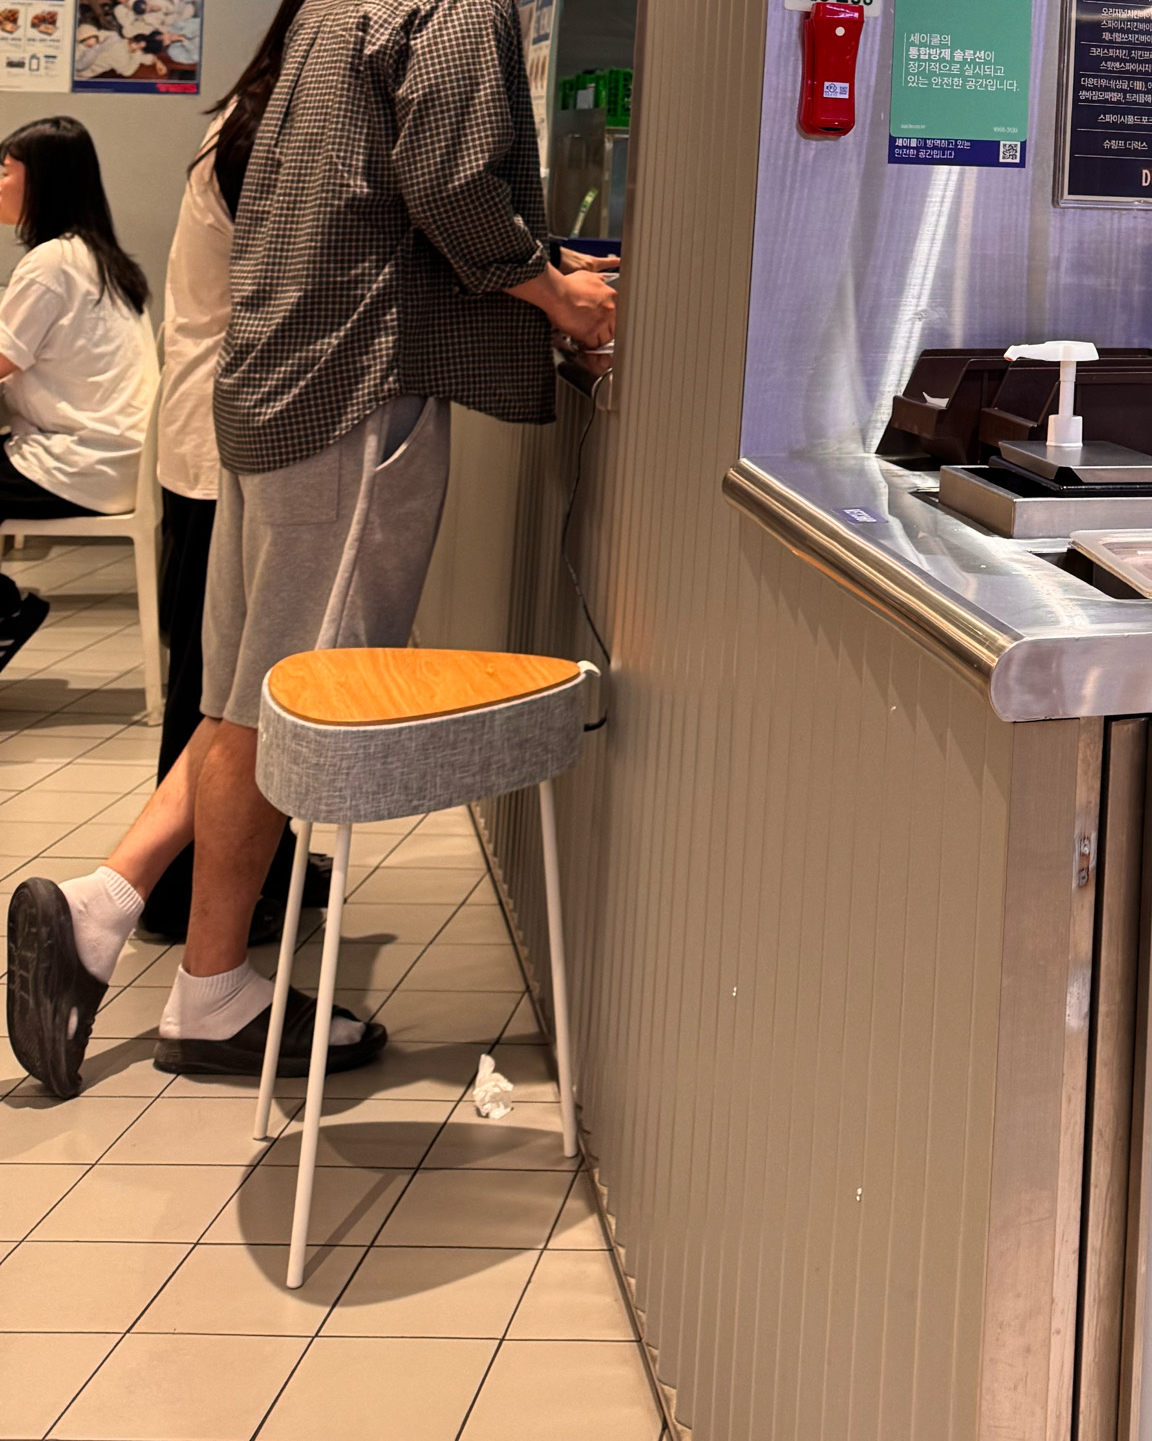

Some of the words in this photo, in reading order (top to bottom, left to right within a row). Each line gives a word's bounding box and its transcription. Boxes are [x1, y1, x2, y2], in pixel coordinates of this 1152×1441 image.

[909, 32, 951, 46] 세이클의
[908, 46, 951, 61] 통합방제
[953, 49, 995, 63] 솔루션이
[908, 61, 960, 74] 정기적으로
[964, 63, 1004, 77] 실시되고
[907, 75, 929, 88] 있는
[931, 76, 962, 89] 안전한
